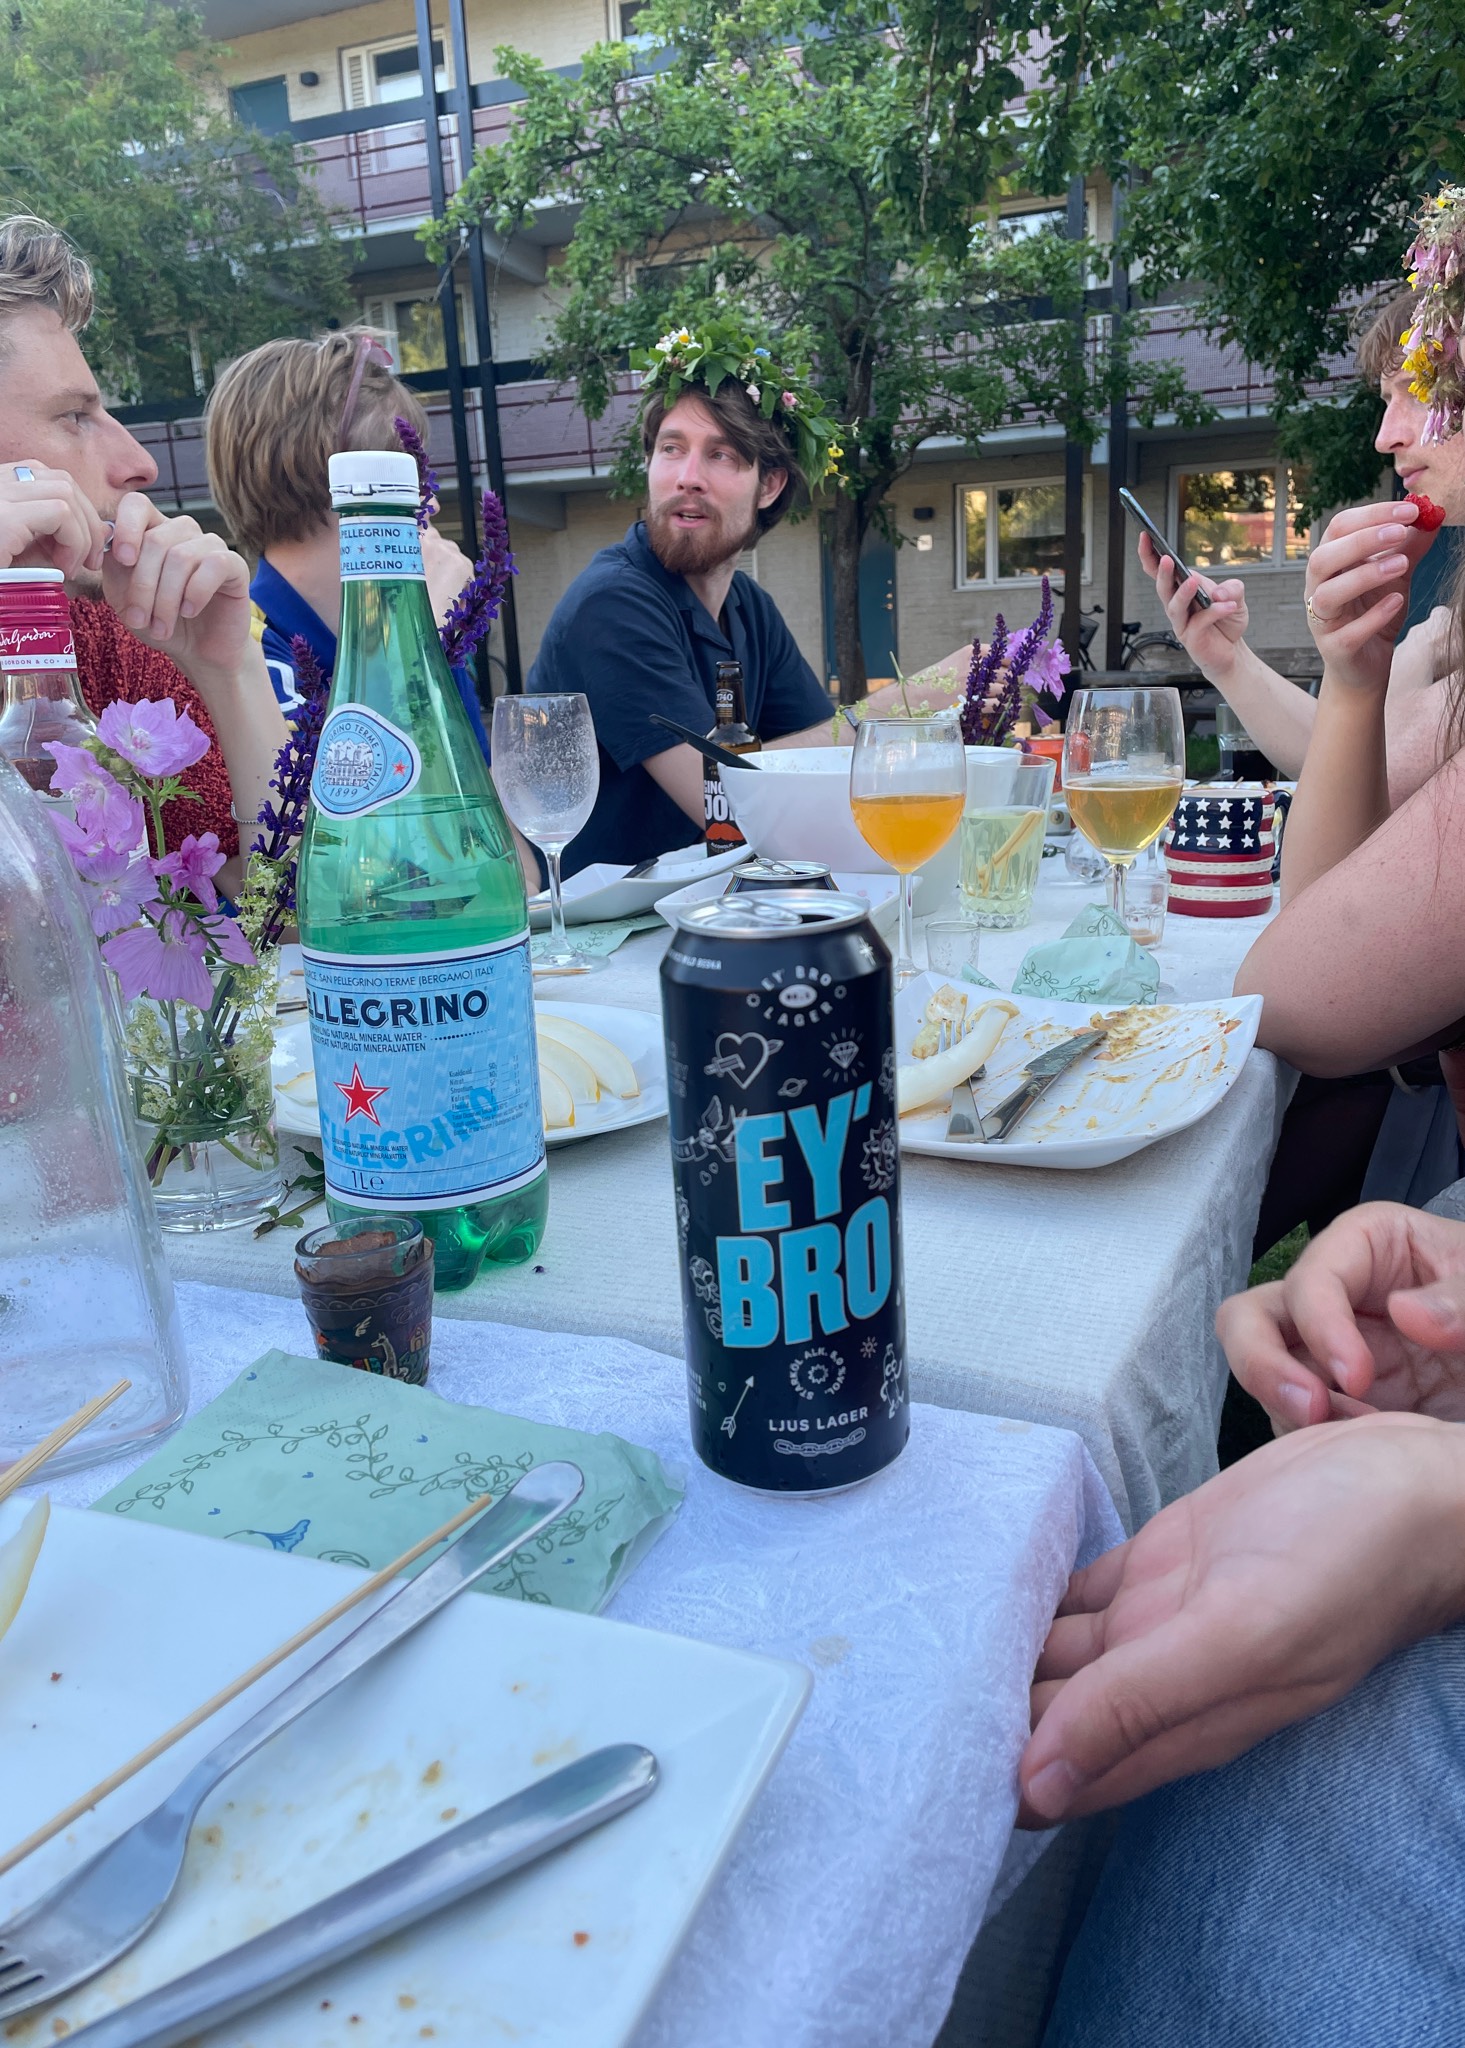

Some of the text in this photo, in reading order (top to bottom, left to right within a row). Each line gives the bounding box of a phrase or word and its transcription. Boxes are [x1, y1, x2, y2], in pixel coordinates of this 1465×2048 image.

[354, 724, 380, 749] TERME
[363, 763, 383, 791] ITALIA
[329, 787, 358, 798] 1899
[334, 975, 383, 988] PELLEGRINO
[385, 976, 416, 988] TERME
[418, 969, 473, 987] (BERGAMO)
[475, 965, 495, 978] ITALY
[795, 964, 832, 988] BRO
[763, 1001, 834, 1028] LAGER
[330, 1029, 358, 1042] NATURAL
[359, 1032, 393, 1043] MINERAL
[394, 1032, 423, 1042] WATER
[363, 1042, 426, 1053] MINERALVATTEN
[715, 1194, 893, 1349] BRO
[768, 1406, 869, 1432] LJUS LAGER
